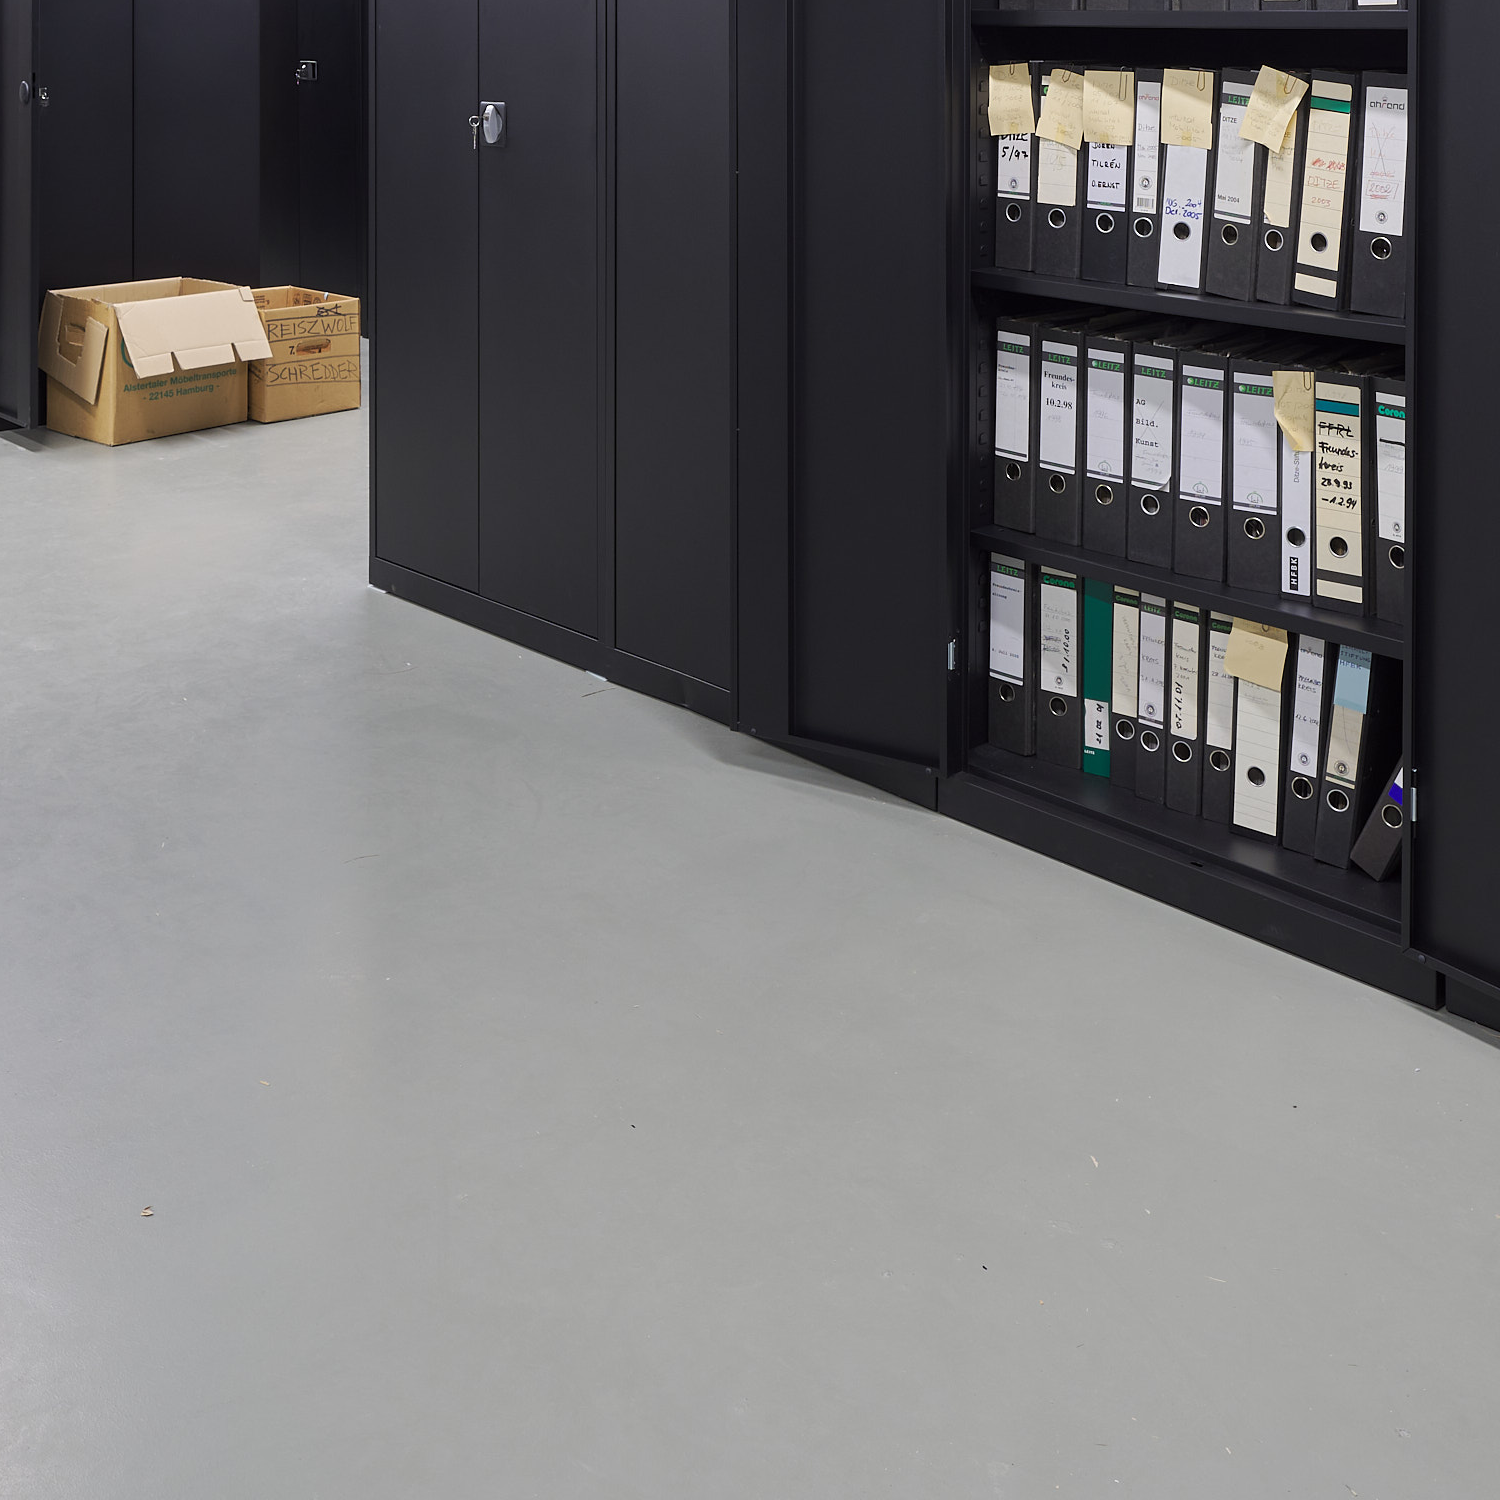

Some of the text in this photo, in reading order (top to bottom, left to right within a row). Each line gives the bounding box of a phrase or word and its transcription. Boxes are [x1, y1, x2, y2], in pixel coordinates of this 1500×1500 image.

[1369, 98, 1405, 111] ahrend
[1222, 115, 1237, 124] DITZE
[1003, 344, 1024, 353] LEITZ
[1048, 354, 1071, 364] LEITZ
[1098, 361, 1120, 371] LEITZ
[265, 360, 358, 383] SCHREDDER
[1044, 370, 1075, 383] Freundes-
[1141, 367, 1166, 378] LEITZ
[123, 367, 238, 393] Alstertaler Möbeltransporte
[1194, 379, 1219, 389] LEITZ
[1051, 381, 1067, 390] kreis
[149, 384, 212, 401] 22145 Hamburg
[1246, 386, 1273, 396] LEITZ
[1046, 398, 1073, 410] 10.2.98
[1135, 398, 1146, 406] AG
[1135, 418, 1159, 428] Bild.
[1135, 438, 1159, 448] Kunst
[997, 565, 1018, 577] LEITZ
[1044, 575, 1075, 588] Corona
[1340, 660, 1362, 670] HFBK
